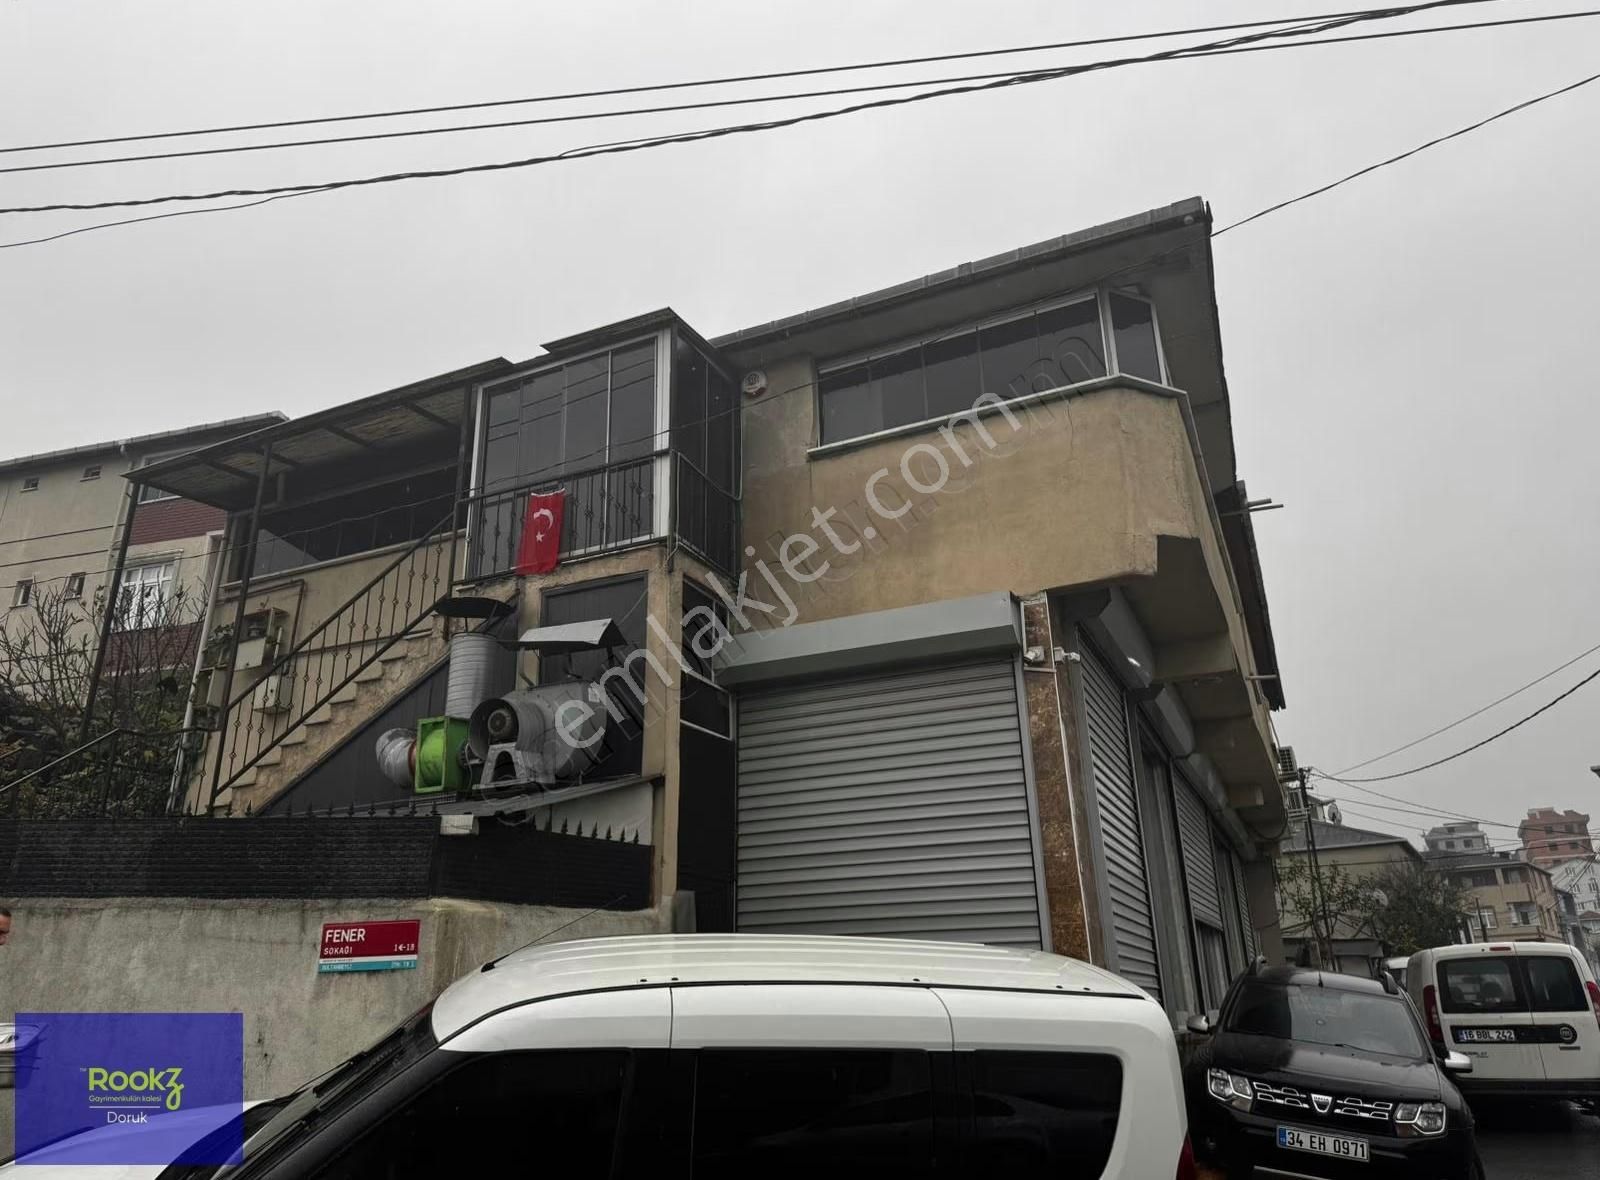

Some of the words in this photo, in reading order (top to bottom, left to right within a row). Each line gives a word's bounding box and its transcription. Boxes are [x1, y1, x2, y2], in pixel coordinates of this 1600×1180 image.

[325, 928, 366, 943] FENER
[323, 945, 353, 956] SOKAĞI
[1495, 1030, 1513, 1040] 242
[1287, 1131, 1303, 1147] 34
[1309, 1135, 1326, 1151] EH
[1333, 1139, 1365, 1157] 0971
